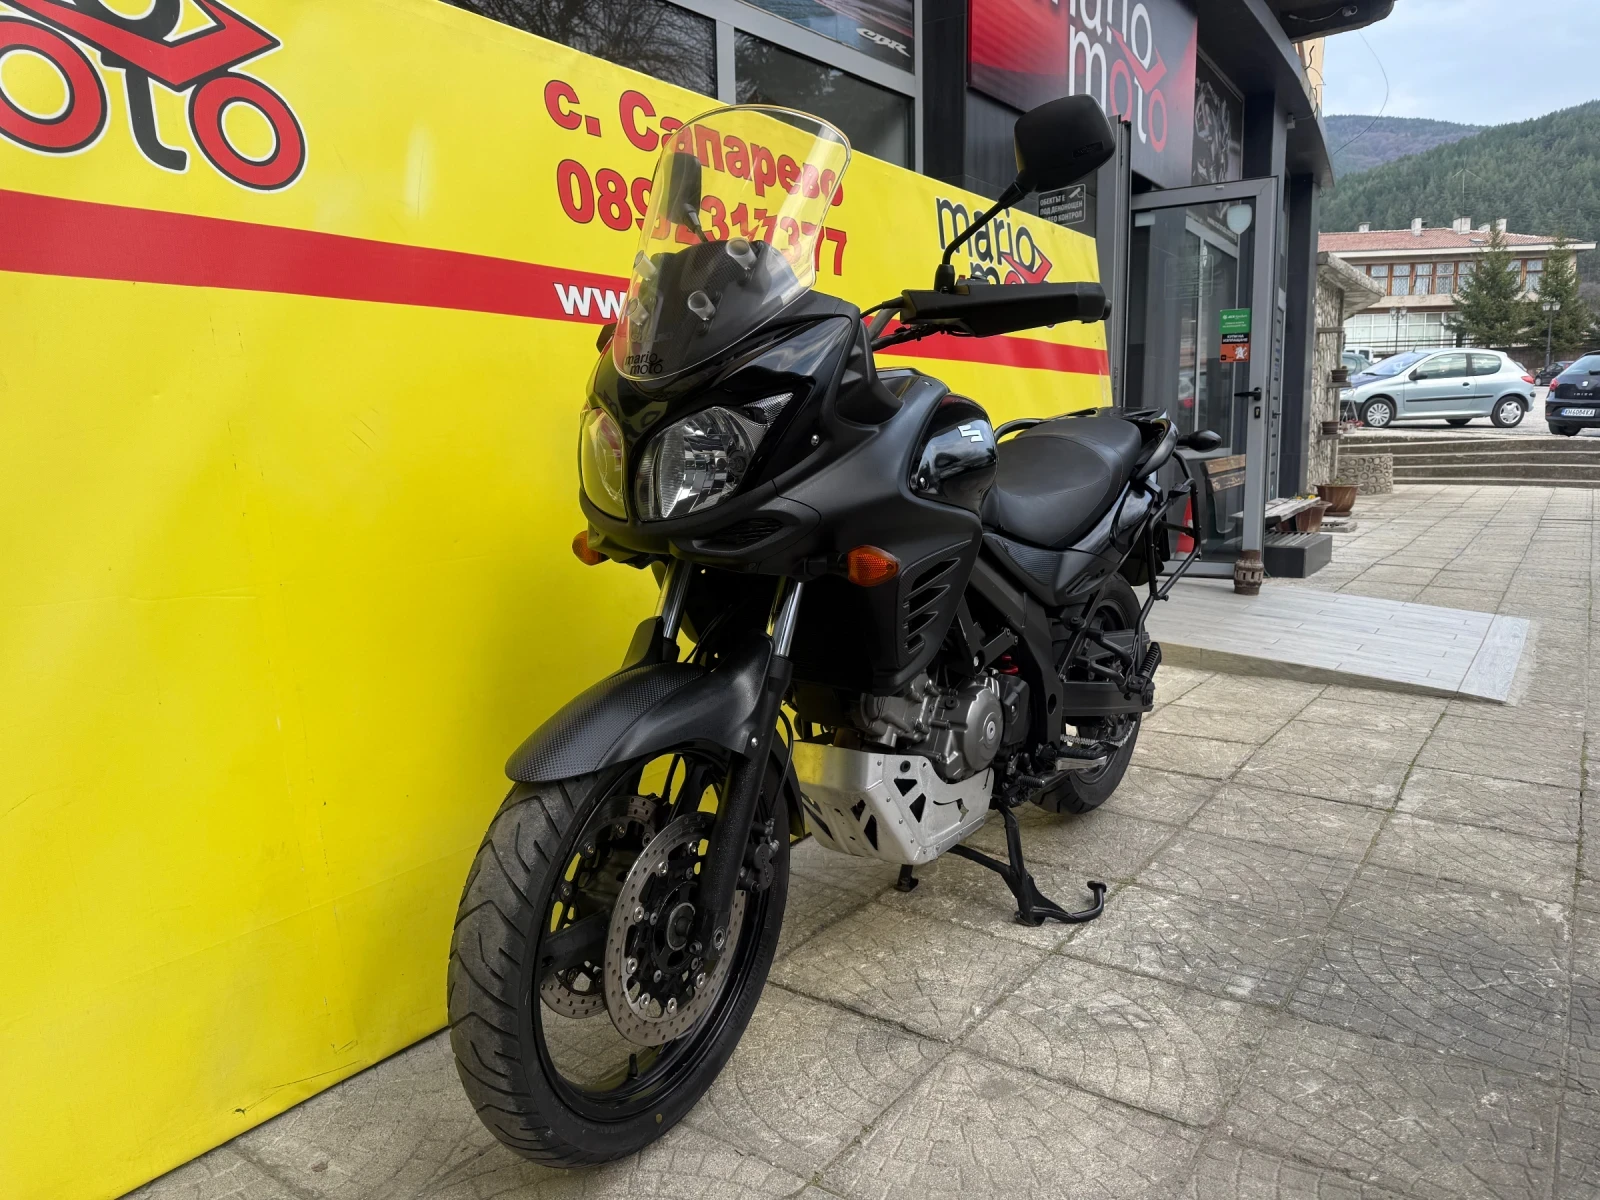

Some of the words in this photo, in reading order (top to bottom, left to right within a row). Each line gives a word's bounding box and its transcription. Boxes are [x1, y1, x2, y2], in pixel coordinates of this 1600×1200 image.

[543, 79, 602, 138] с.
[618, 89, 844, 207] Сапарево
[935, 197, 1036, 273] mario
[625, 351, 658, 366] mario
[629, 362, 663, 375] moto
